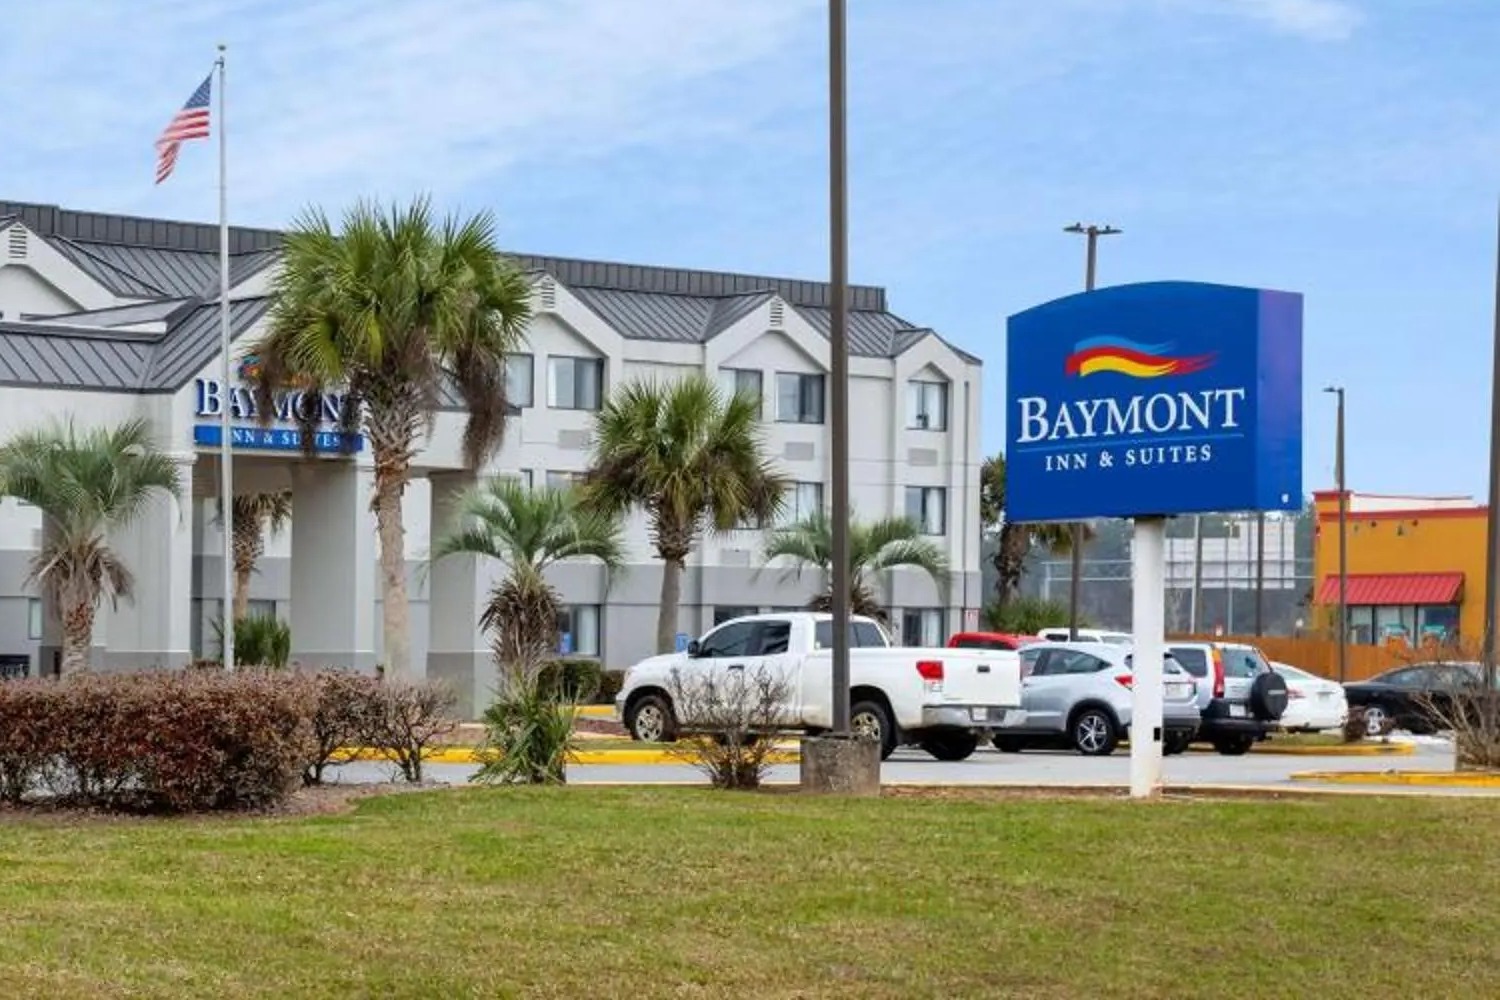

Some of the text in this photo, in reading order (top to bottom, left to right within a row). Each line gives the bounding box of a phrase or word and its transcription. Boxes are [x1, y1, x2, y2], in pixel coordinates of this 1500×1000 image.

[1016, 388, 1245, 443] BAYMONT
[224, 428, 255, 444] NN
[263, 432, 273, 445] &
[1045, 444, 1212, 472] INN & SUITES
